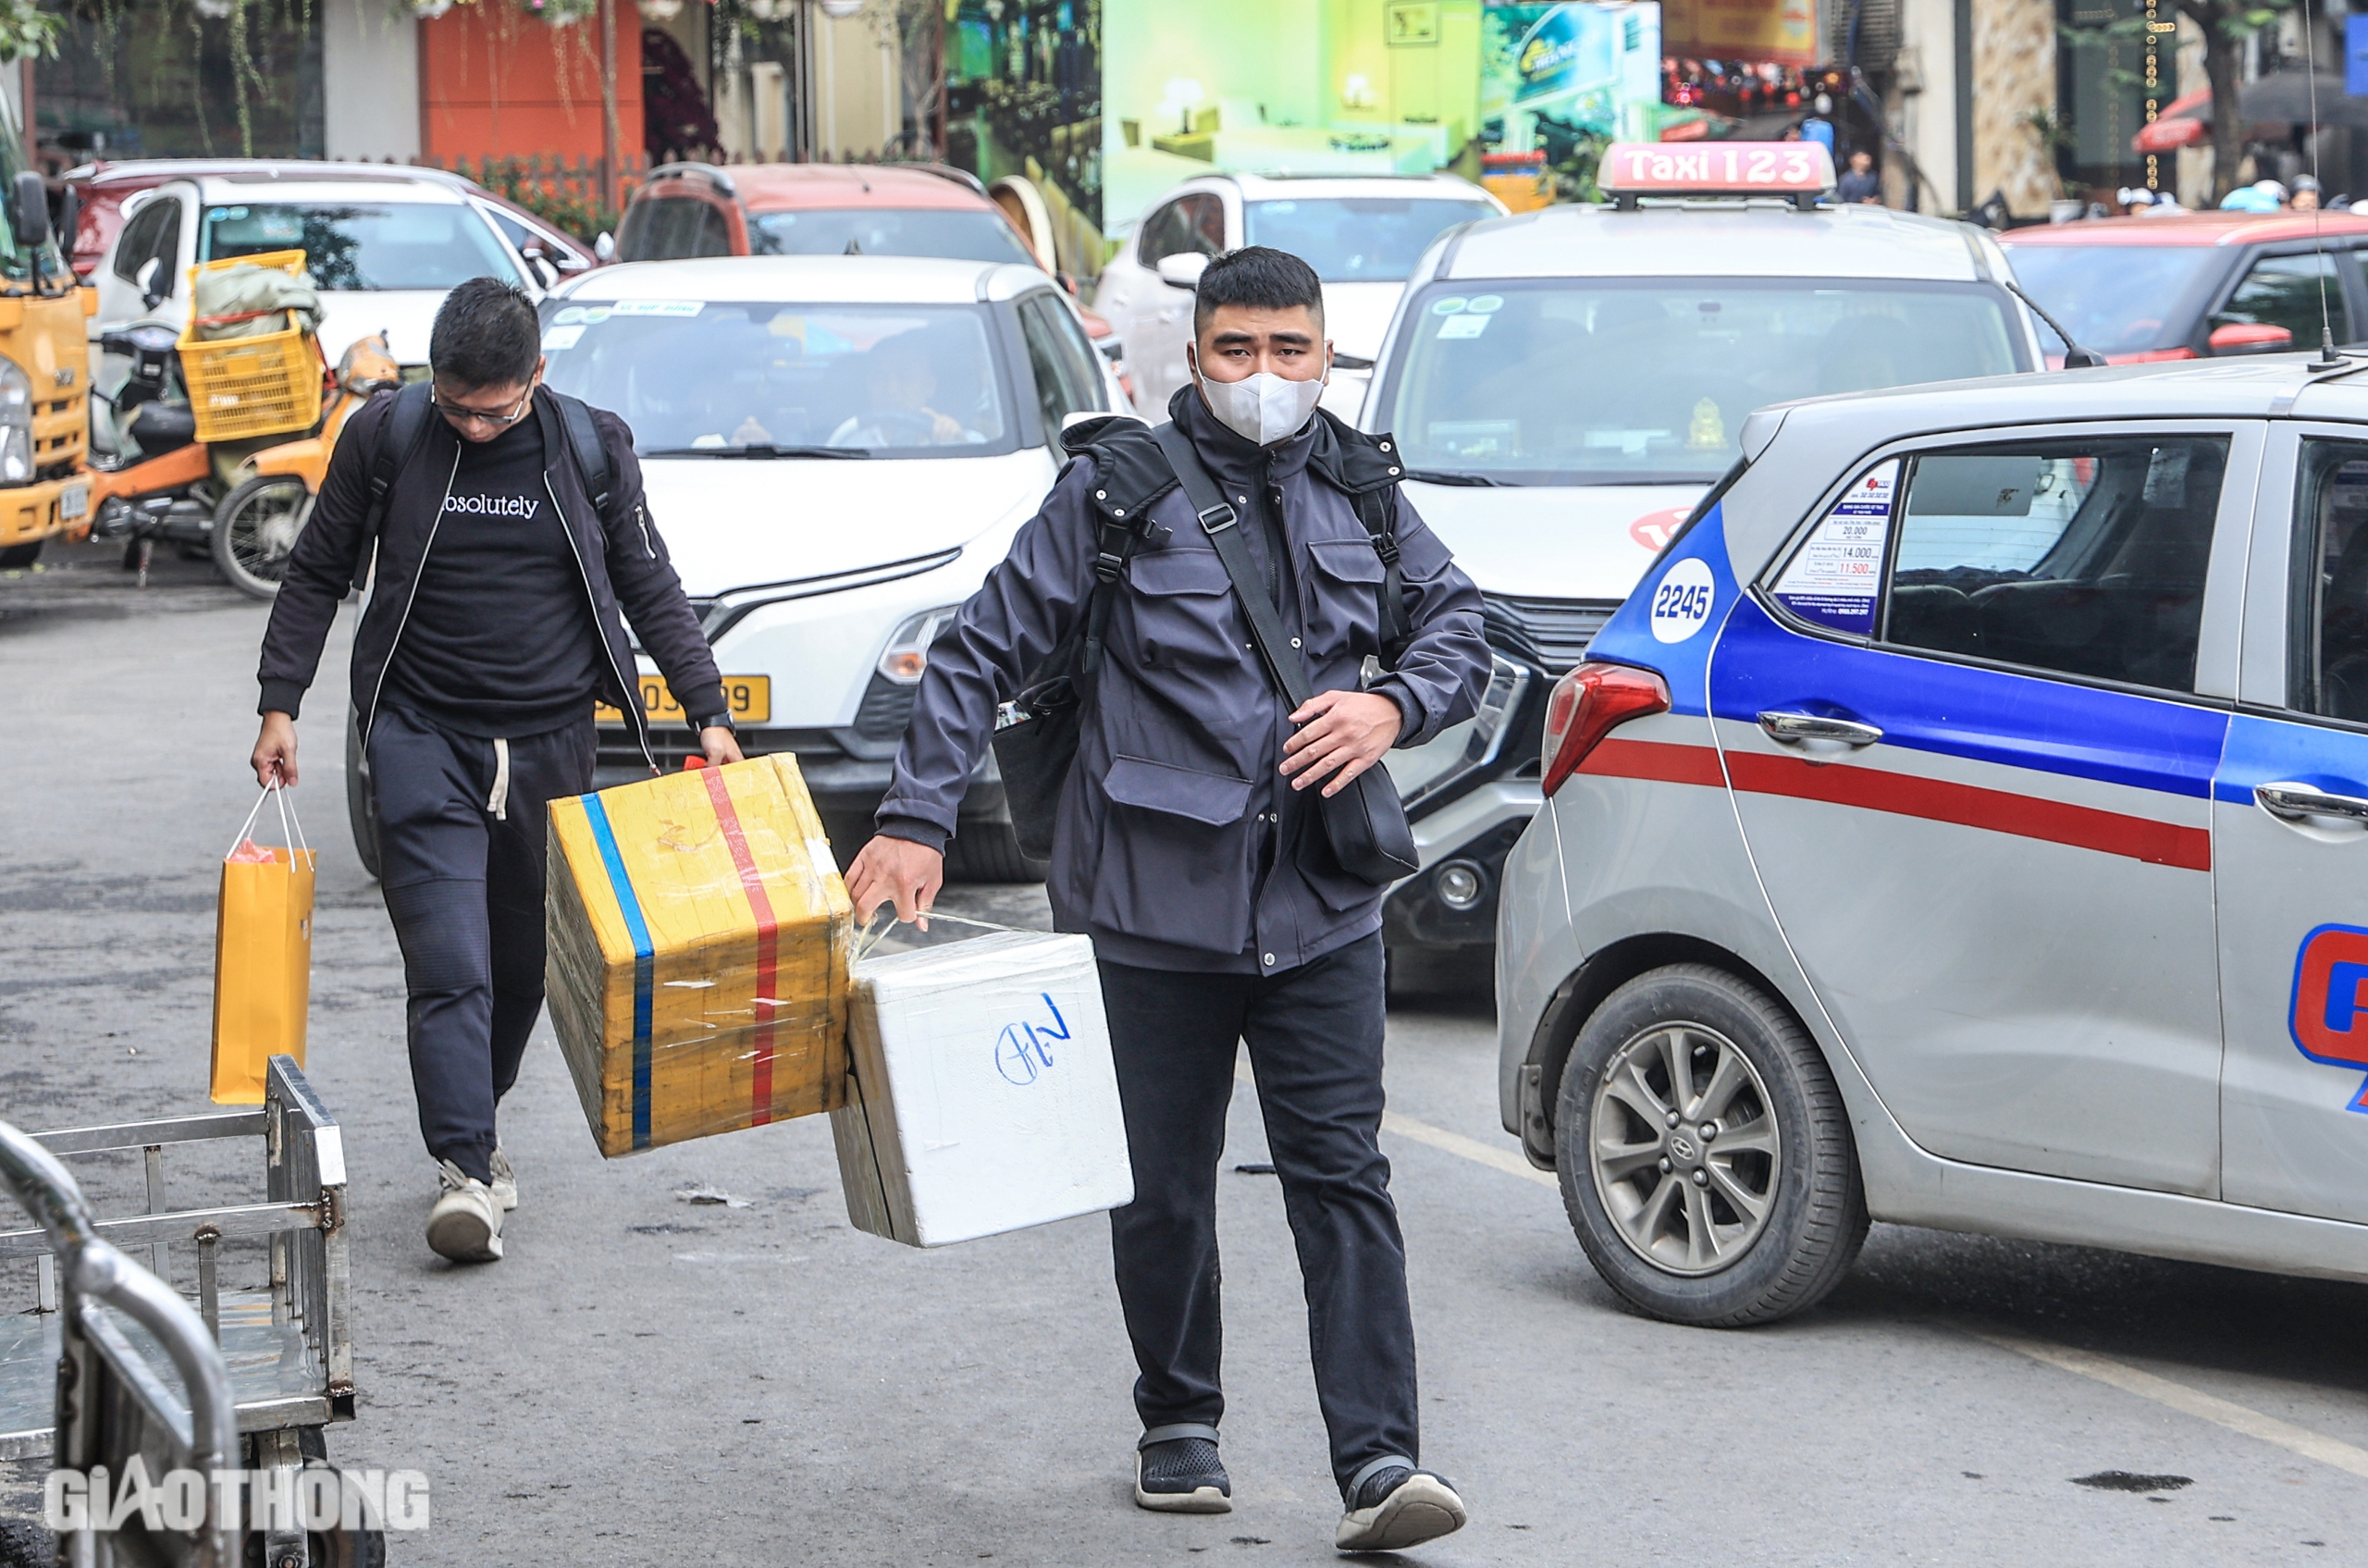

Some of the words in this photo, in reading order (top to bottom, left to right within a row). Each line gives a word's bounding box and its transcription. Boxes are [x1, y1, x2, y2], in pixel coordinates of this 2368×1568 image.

[1622, 149, 1711, 182] Taxi
[443, 493, 539, 520] bsolutely
[1843, 526, 1868, 536] 20.000
[1843, 547, 1872, 558] 14.000
[1840, 562, 1868, 574] 11.500
[1655, 584, 1709, 620] 2245
